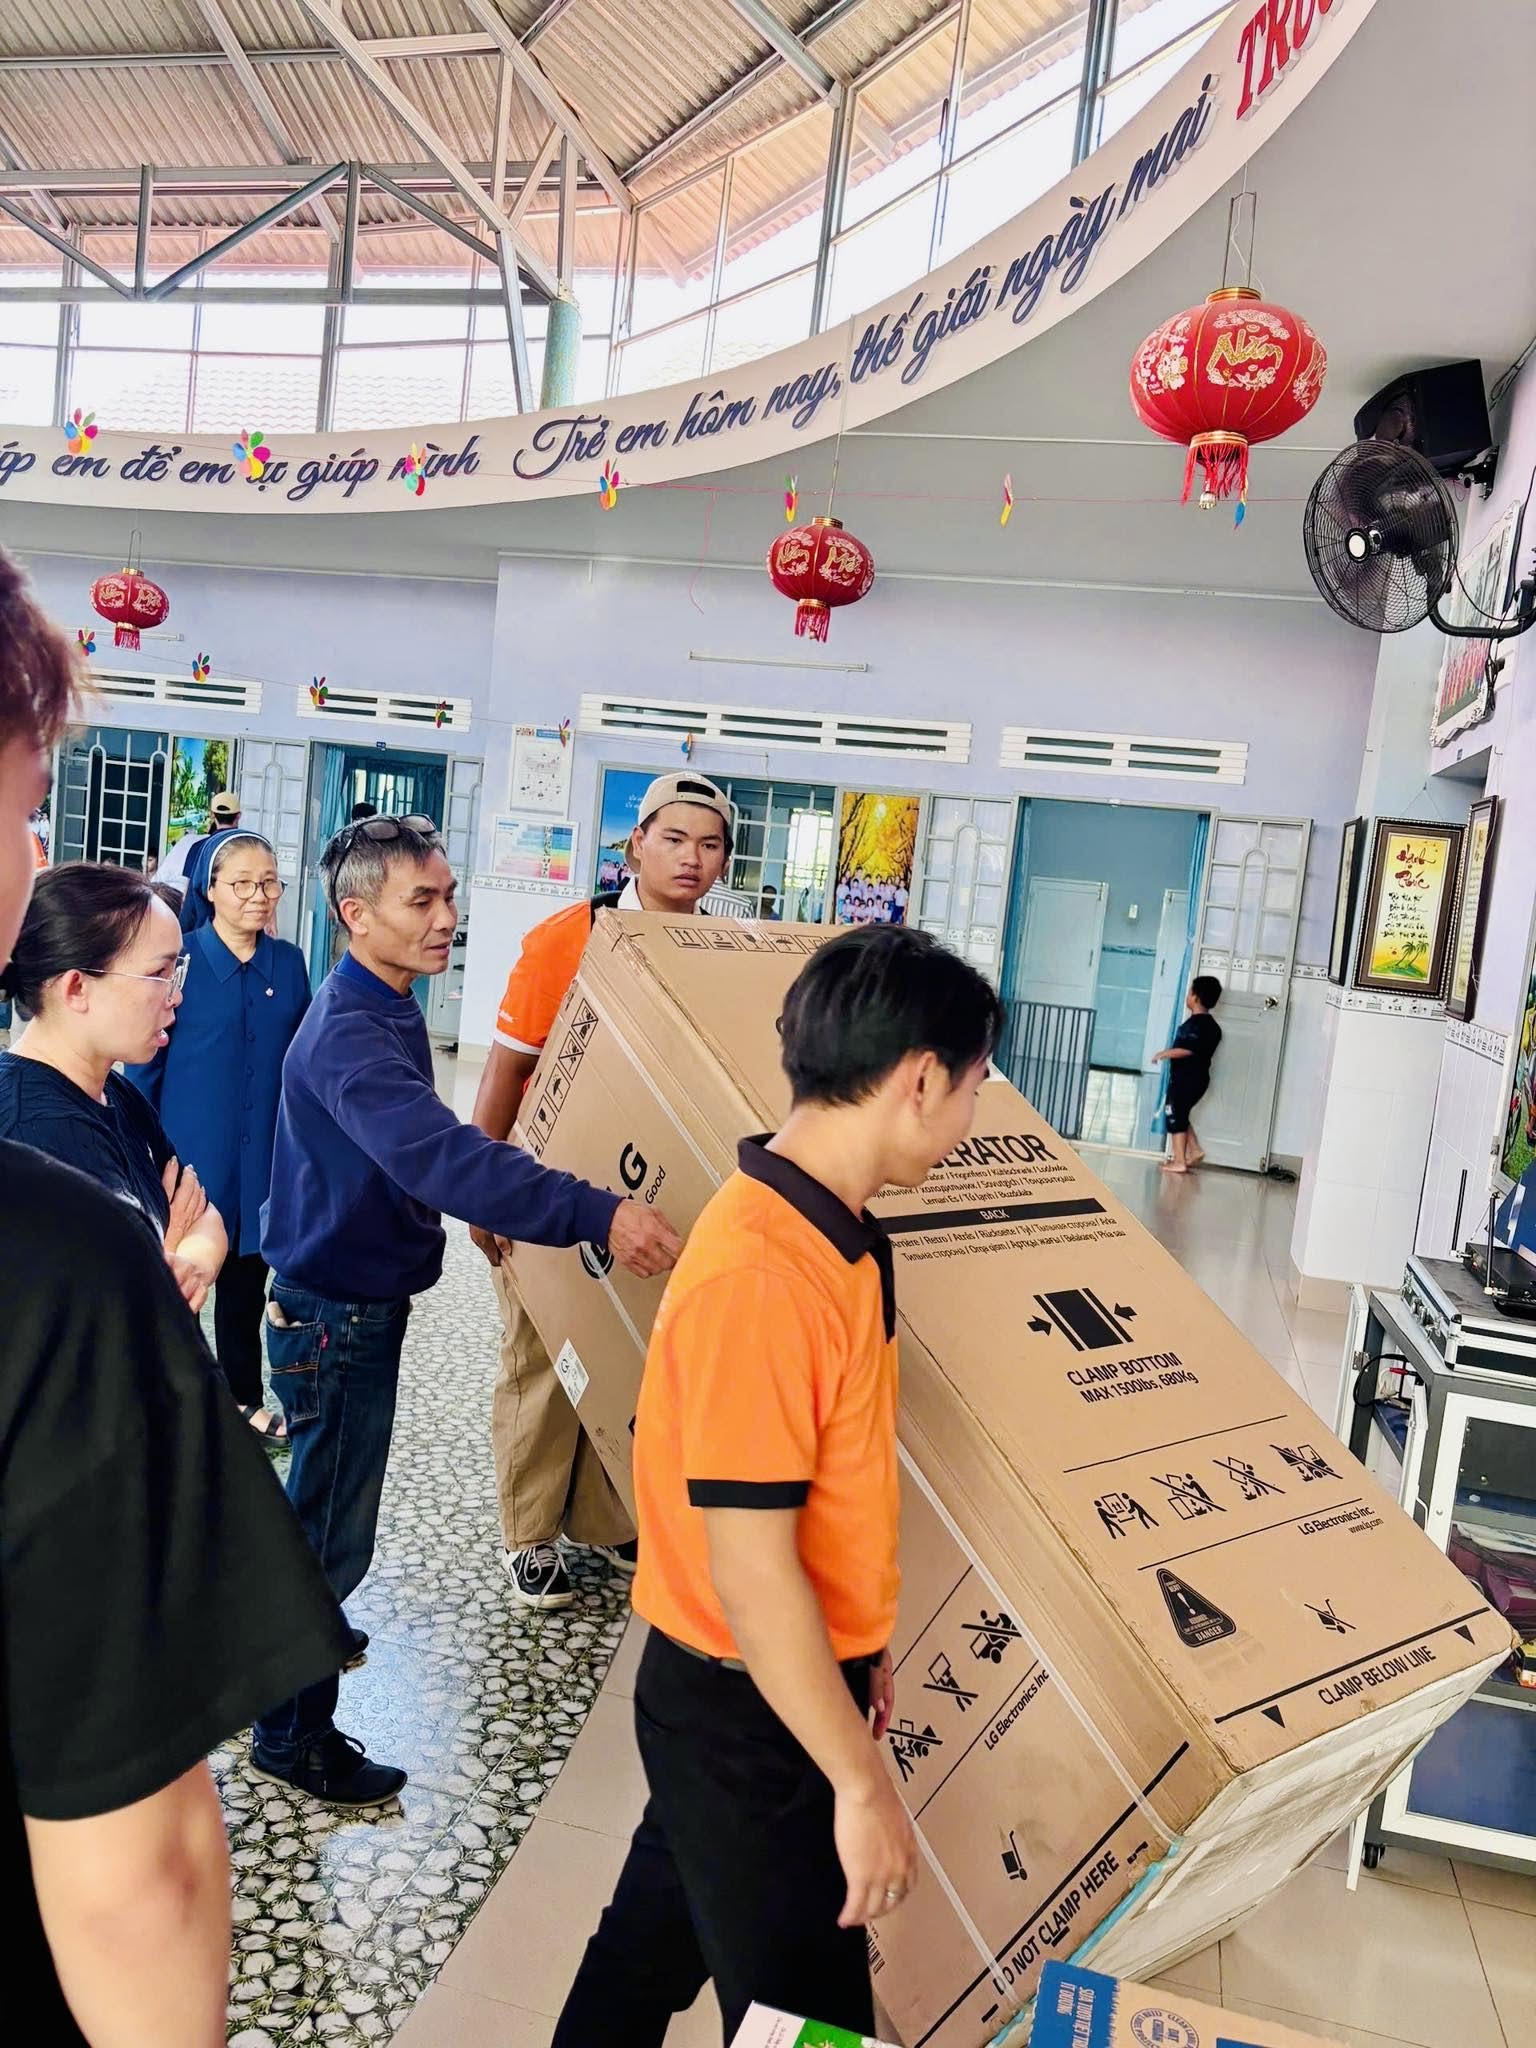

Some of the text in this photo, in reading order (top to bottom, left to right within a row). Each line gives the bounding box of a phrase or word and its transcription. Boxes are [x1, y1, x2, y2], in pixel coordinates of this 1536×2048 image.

[513, 73, 1212, 480] Trẻ em hôm nay, thế giới ngày mai
[52, 455, 110, 477] em
[120, 445, 182, 482] để
[179, 461, 235, 483] em
[287, 448, 379, 501] giúp
[930, 1134, 1058, 1168] ERATOR
[646, 1165, 666, 1204] Good
[979, 1209, 1010, 1220] BACK
[923, 1236, 948, 1244] Retro
[978, 1229, 1016, 1238] Rückseite
[1067, 1352, 1182, 1386] CLAMP BOTTOM
[1080, 1370, 1199, 1403] MAX 1500lbs, 680Kg
[1297, 1506, 1375, 1535] LG Electronics Inc.
[1348, 1518, 1384, 1533] www.lg.com
[1195, 1625, 1224, 1641] DANGER
[1318, 1645, 1437, 1706] CLAMP BELOW LINE
[984, 1730, 999, 1750] LG
[995, 1683, 1038, 1736] Electronics
[1012, 1935, 1041, 1975] NOT
[1038, 1889, 1081, 1945] CLAMP
[1079, 1850, 1119, 1898] HERE
